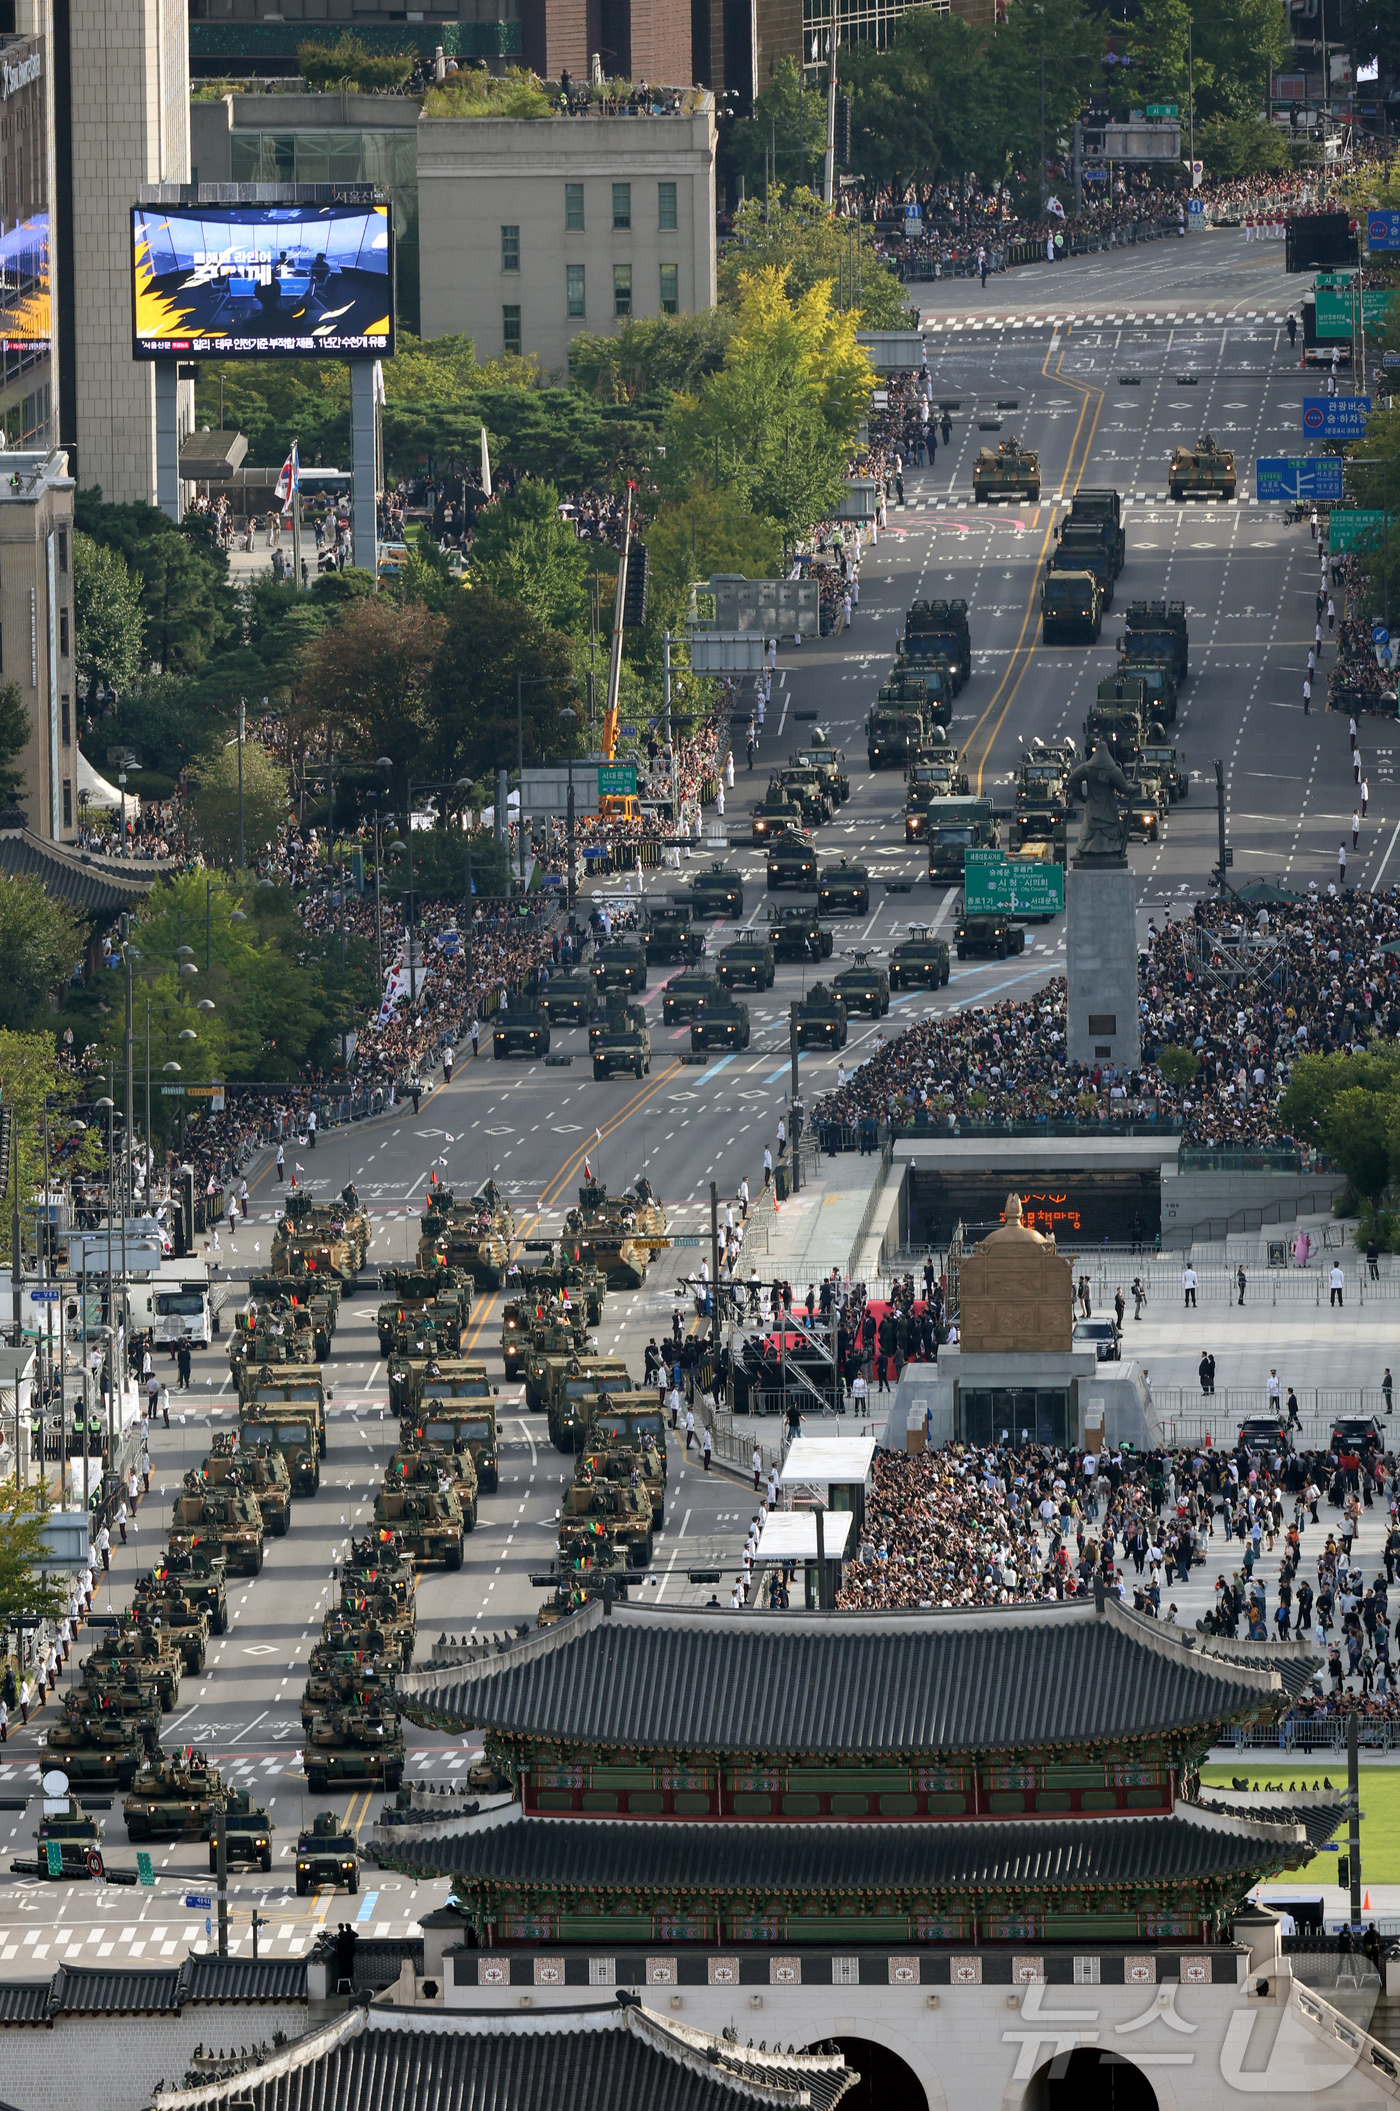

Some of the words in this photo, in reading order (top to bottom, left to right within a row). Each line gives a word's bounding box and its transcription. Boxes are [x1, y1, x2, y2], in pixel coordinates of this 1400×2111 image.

[1329, 402, 1367, 412] 관광버스
[602, 771, 633, 780] 서대문역
[970, 853, 1001, 861] 세종대로사거리
[1024, 879, 1048, 887] 시의회
[967, 897, 994, 905] 종로1가
[999, 1209, 1081, 1230] 문책마당
[90, 1858, 99, 1870] 40
